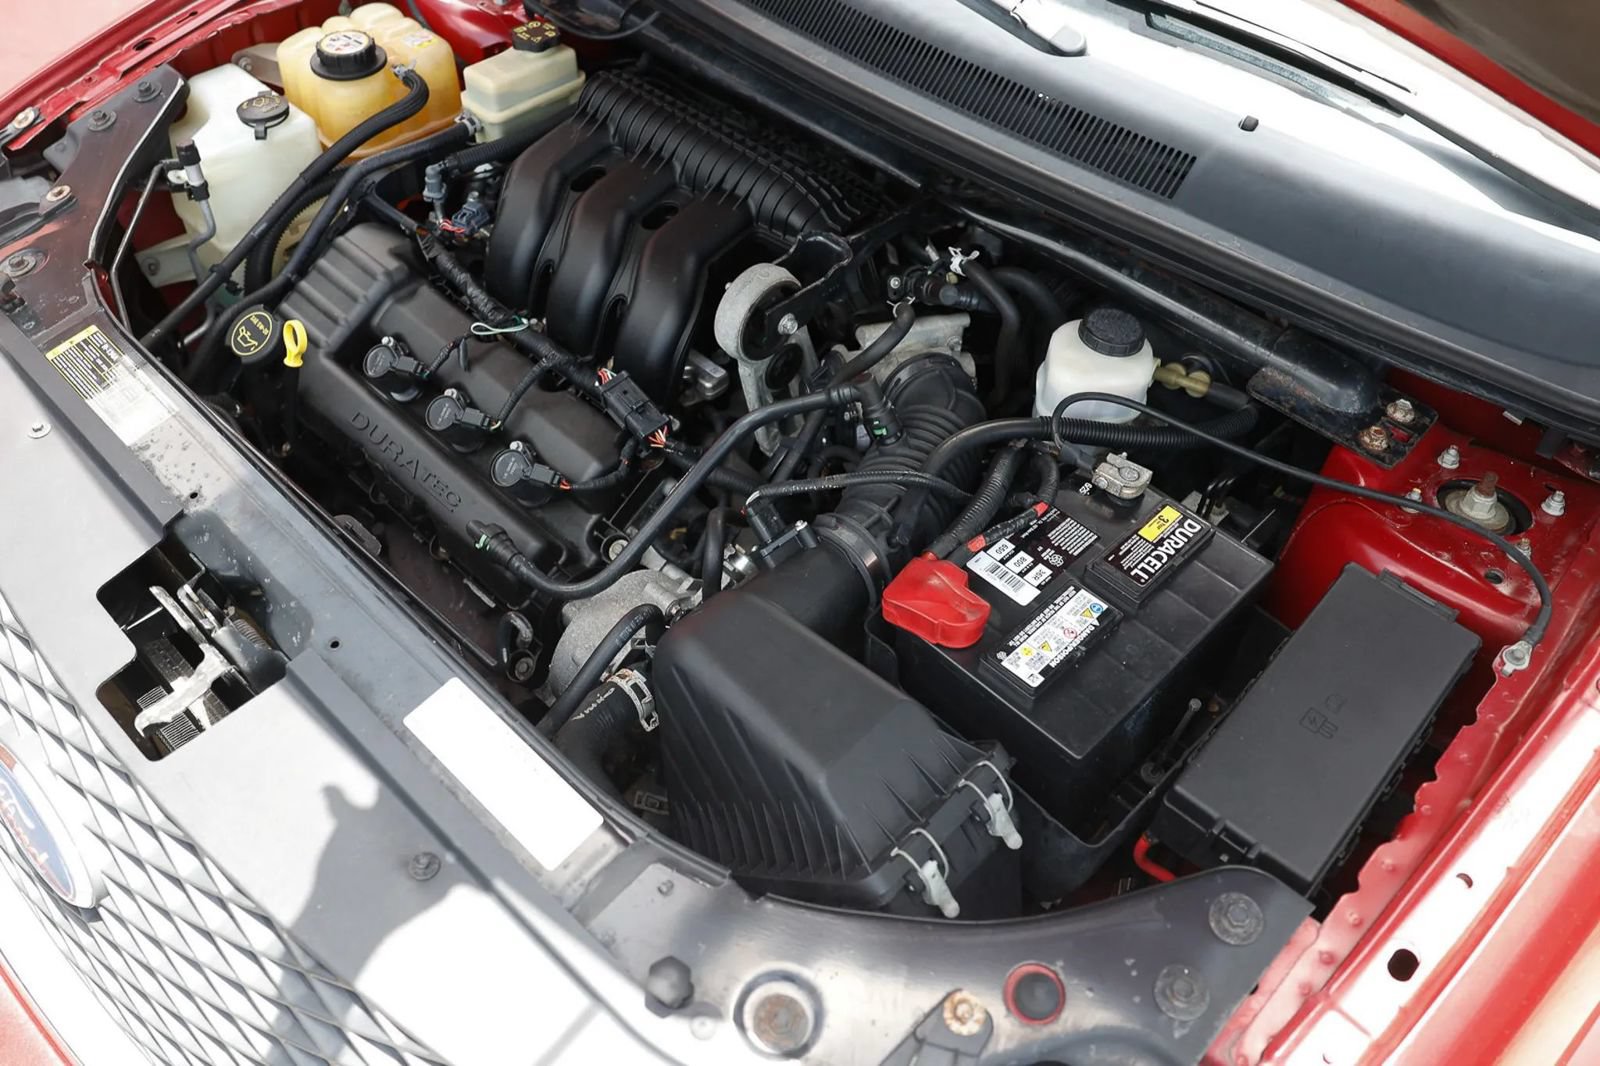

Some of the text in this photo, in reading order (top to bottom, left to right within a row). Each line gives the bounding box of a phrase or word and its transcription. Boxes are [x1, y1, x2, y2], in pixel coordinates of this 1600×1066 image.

[351, 411, 462, 508] DURATEC
[1130, 518, 1202, 581] DURACELL
[1158, 515, 1169, 524] 3
